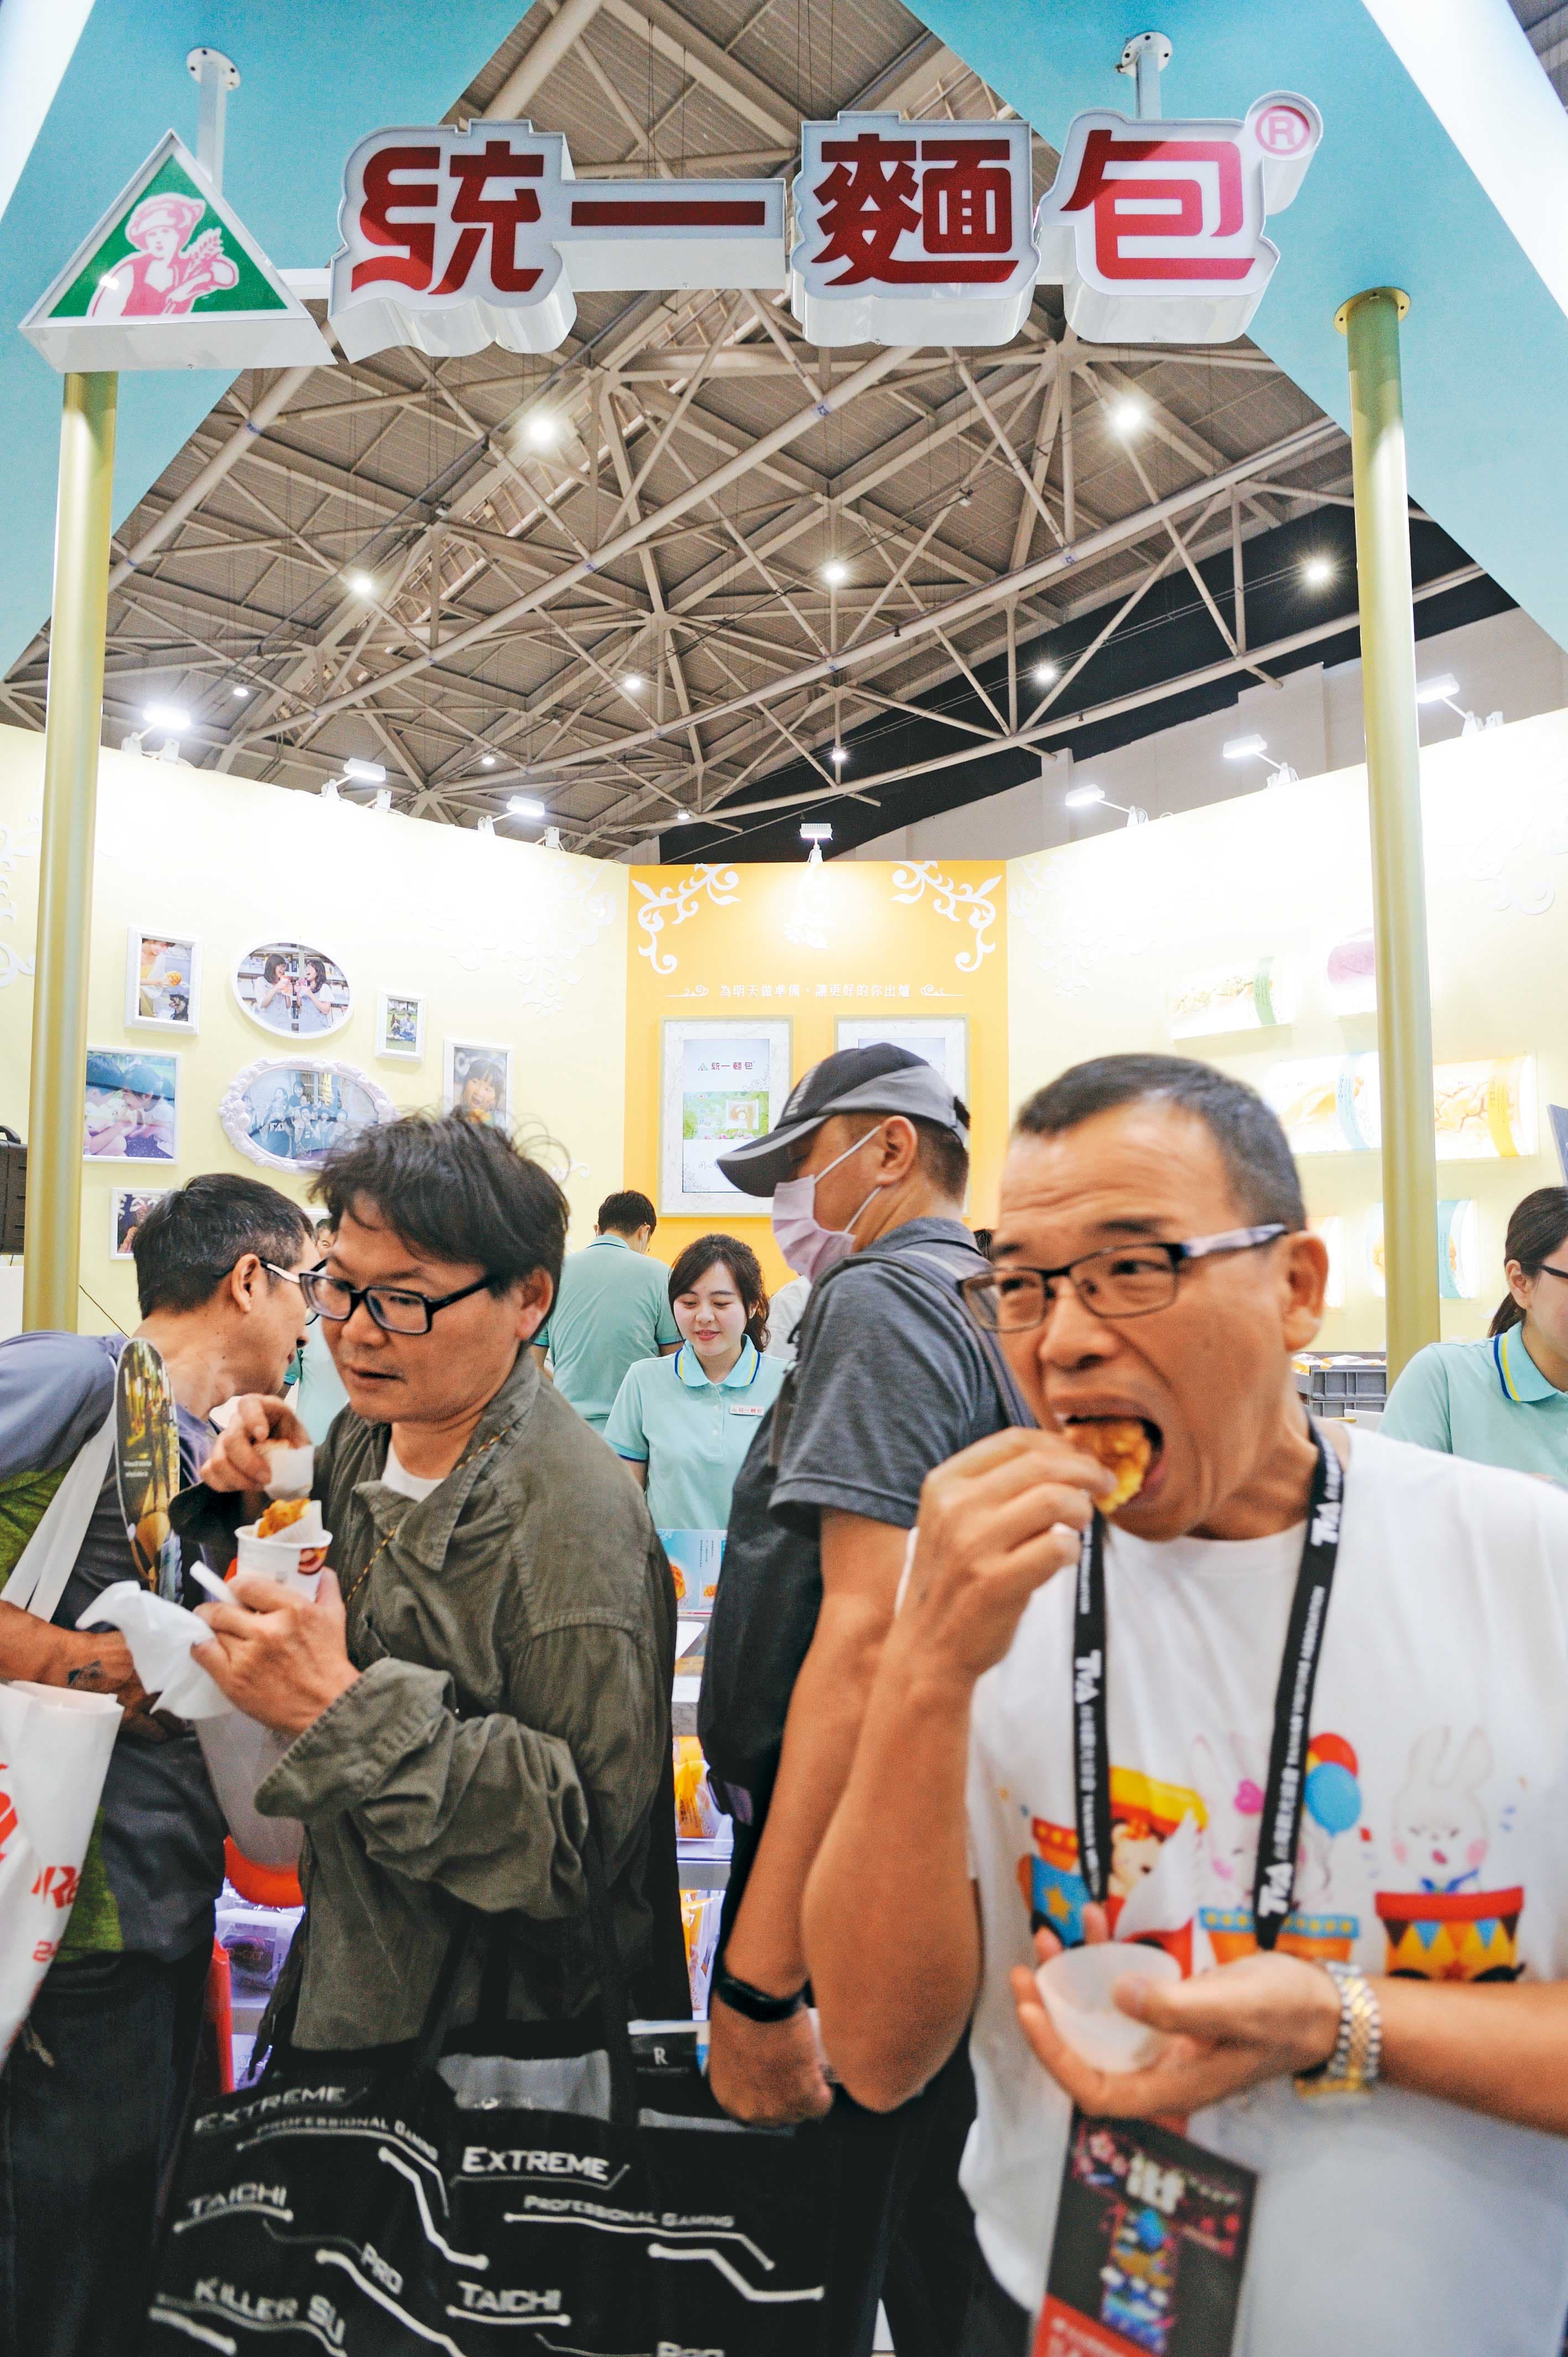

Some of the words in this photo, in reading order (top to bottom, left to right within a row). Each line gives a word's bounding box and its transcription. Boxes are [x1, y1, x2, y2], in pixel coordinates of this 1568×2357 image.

[351, 130, 1256, 294] 統一麵包
[194, 2086, 347, 2132] EXTREME
[462, 2146, 610, 2181] EXTREME
[187, 2182, 287, 2217] TAICHI
[194, 2277, 298, 2322] KILLER
[458, 2281, 561, 2312] TAICHI
